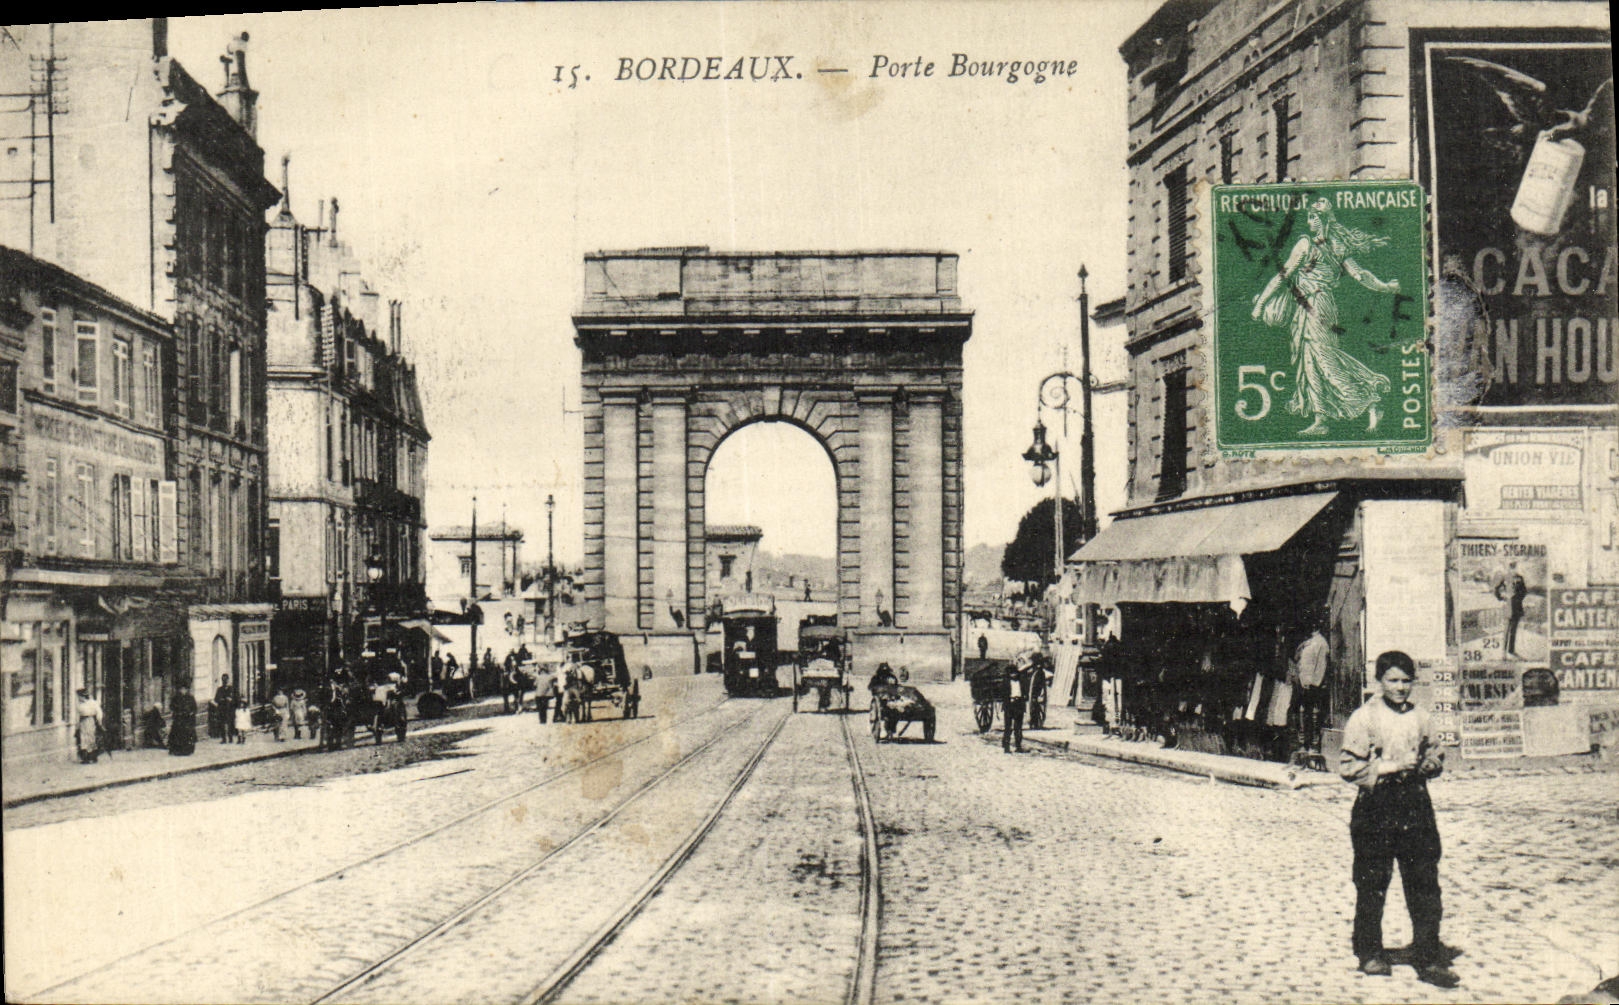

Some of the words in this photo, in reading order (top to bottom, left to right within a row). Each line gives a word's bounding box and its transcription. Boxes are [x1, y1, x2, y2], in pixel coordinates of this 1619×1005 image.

[1336, 190, 1417, 211] FRANÇAISE
[1589, 185, 1608, 208] la
[1402, 343, 1421, 429] POSTES
[282, 599, 308, 610] PARIS
[1463, 650, 1482, 662] 38
